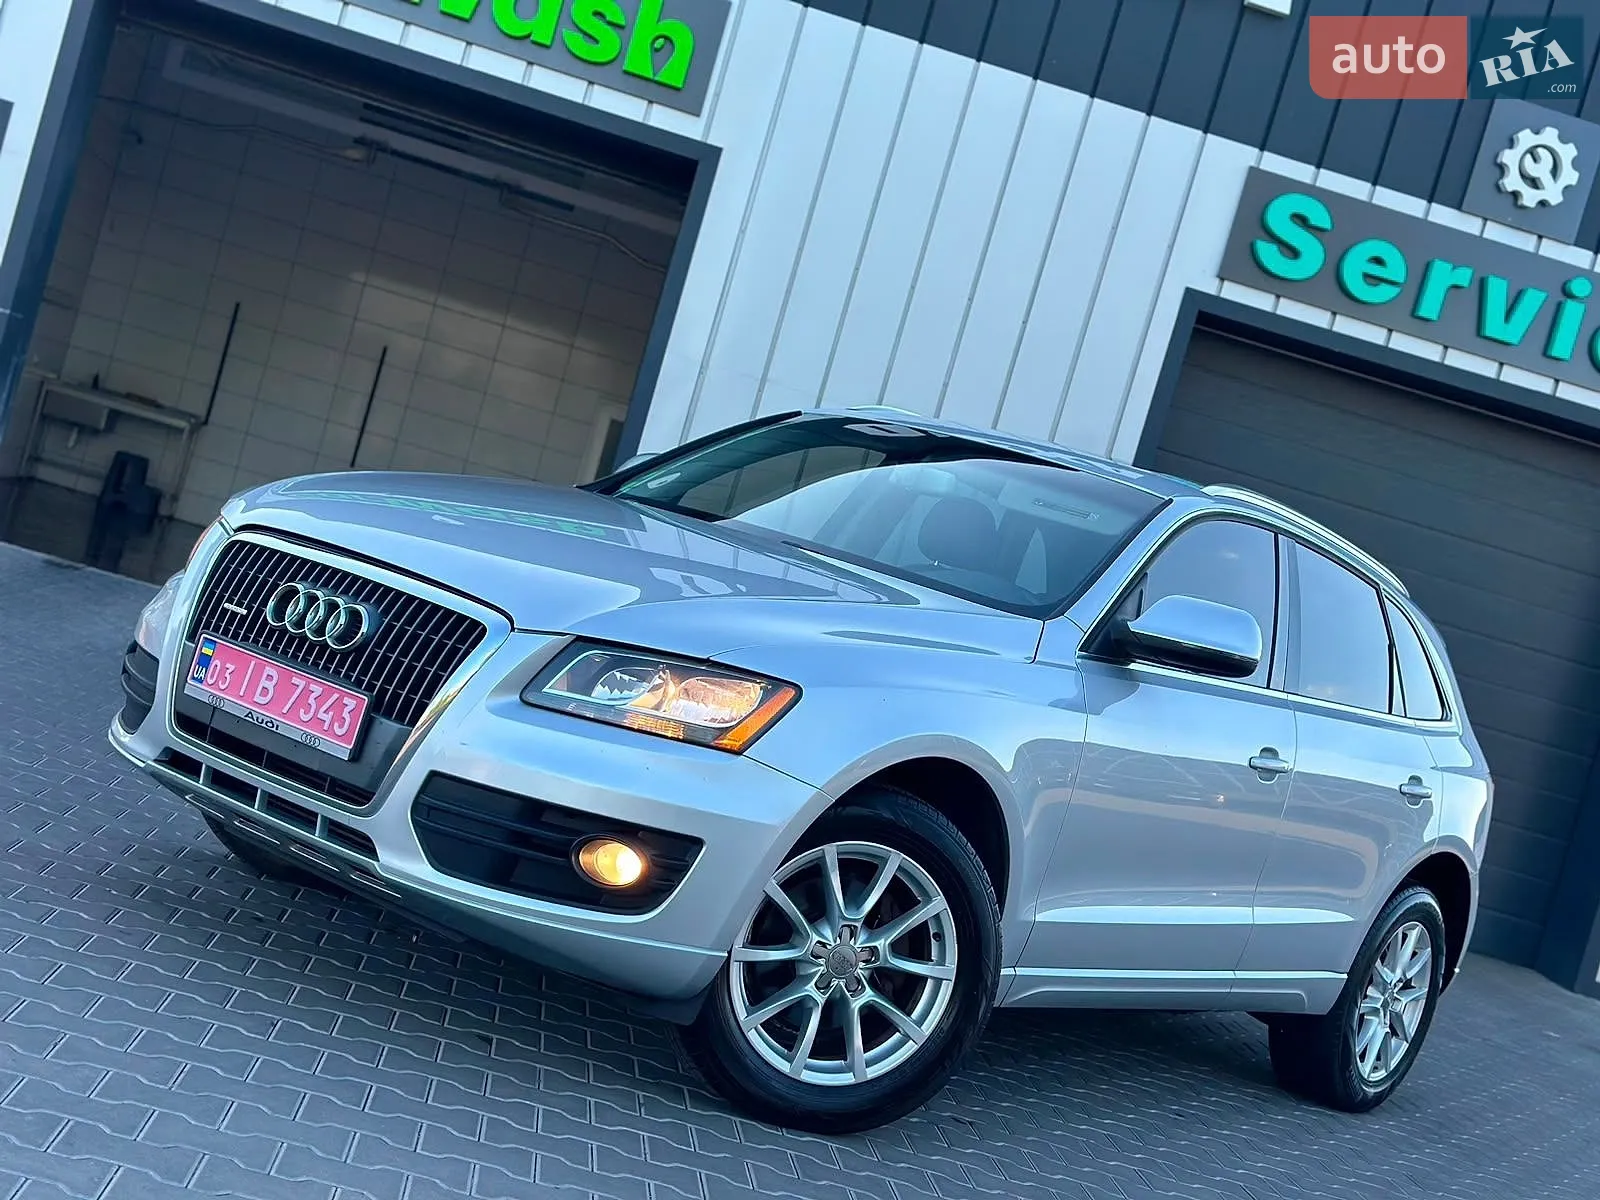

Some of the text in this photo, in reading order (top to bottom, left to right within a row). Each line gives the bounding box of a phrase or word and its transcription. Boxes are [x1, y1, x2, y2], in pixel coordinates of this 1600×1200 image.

[393, 0, 695, 90] ash
[1251, 191, 1600, 374] Servi
[193, 664, 206, 680] UA
[244, 711, 279, 731] Audi
[281, 676, 357, 737] 7343
